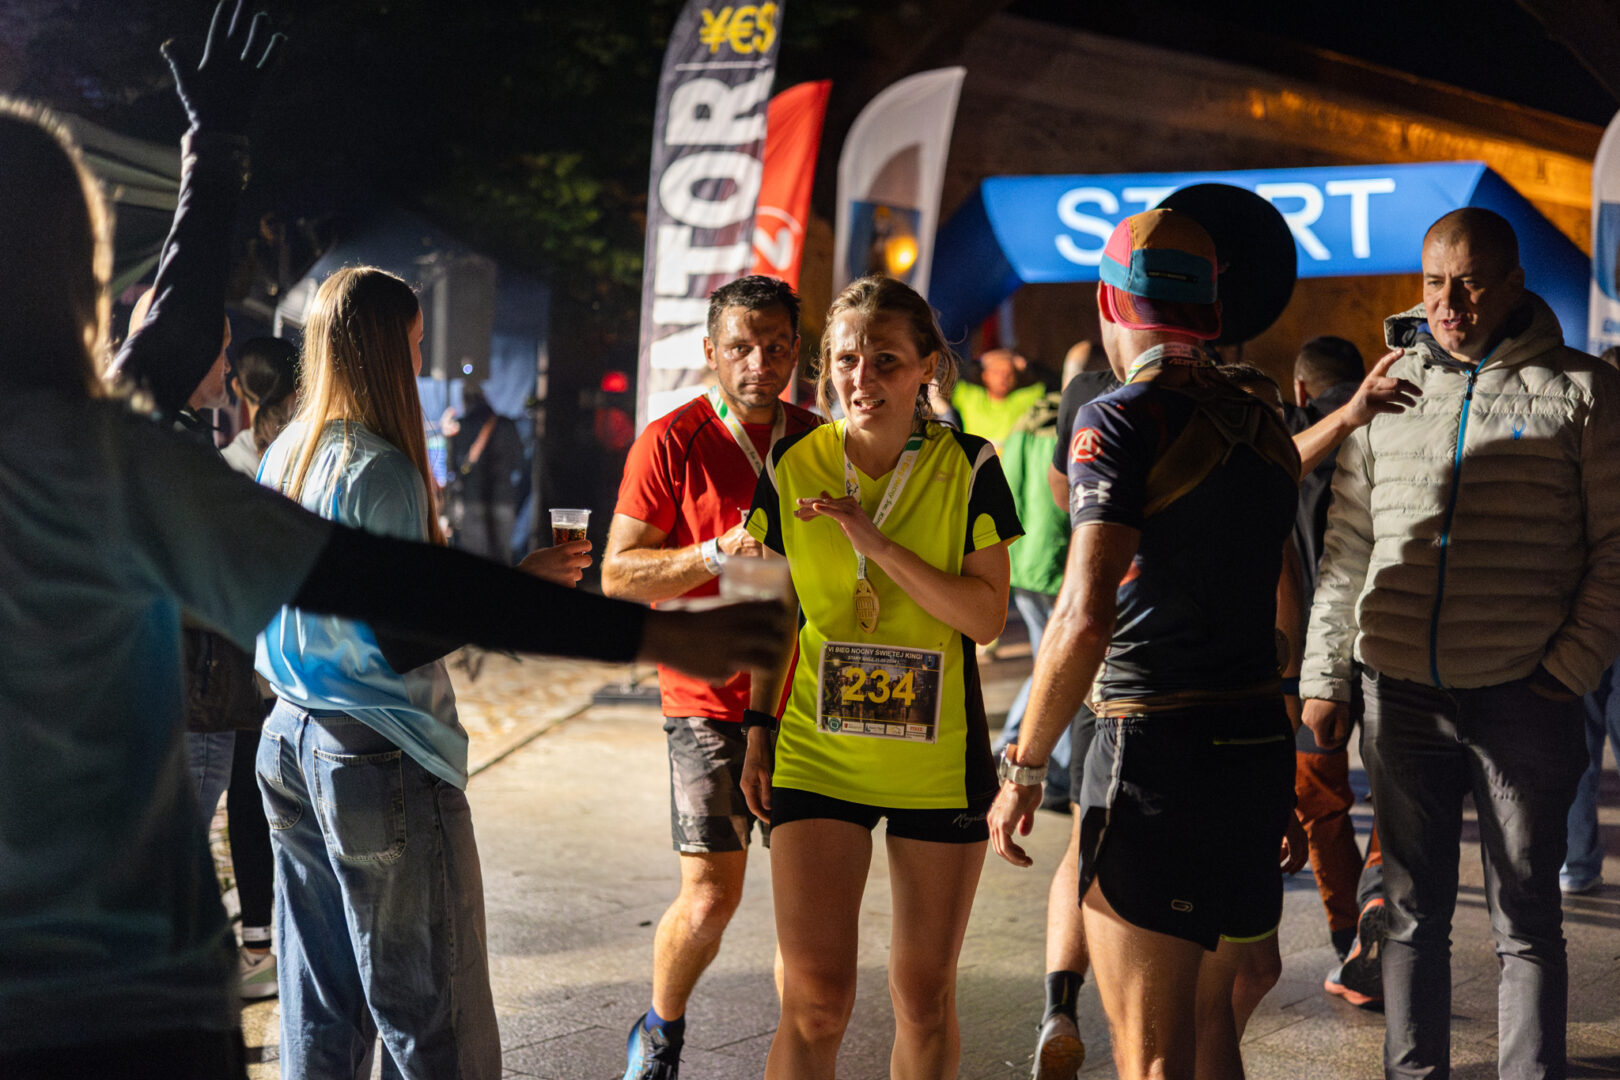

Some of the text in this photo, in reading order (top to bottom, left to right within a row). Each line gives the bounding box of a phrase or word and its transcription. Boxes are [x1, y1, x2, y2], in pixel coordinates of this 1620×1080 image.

[835, 646, 850, 654] BIEG
[851, 647, 874, 656] NOCNY
[904, 651, 923, 660] KINGI
[842, 667, 916, 706] 234
